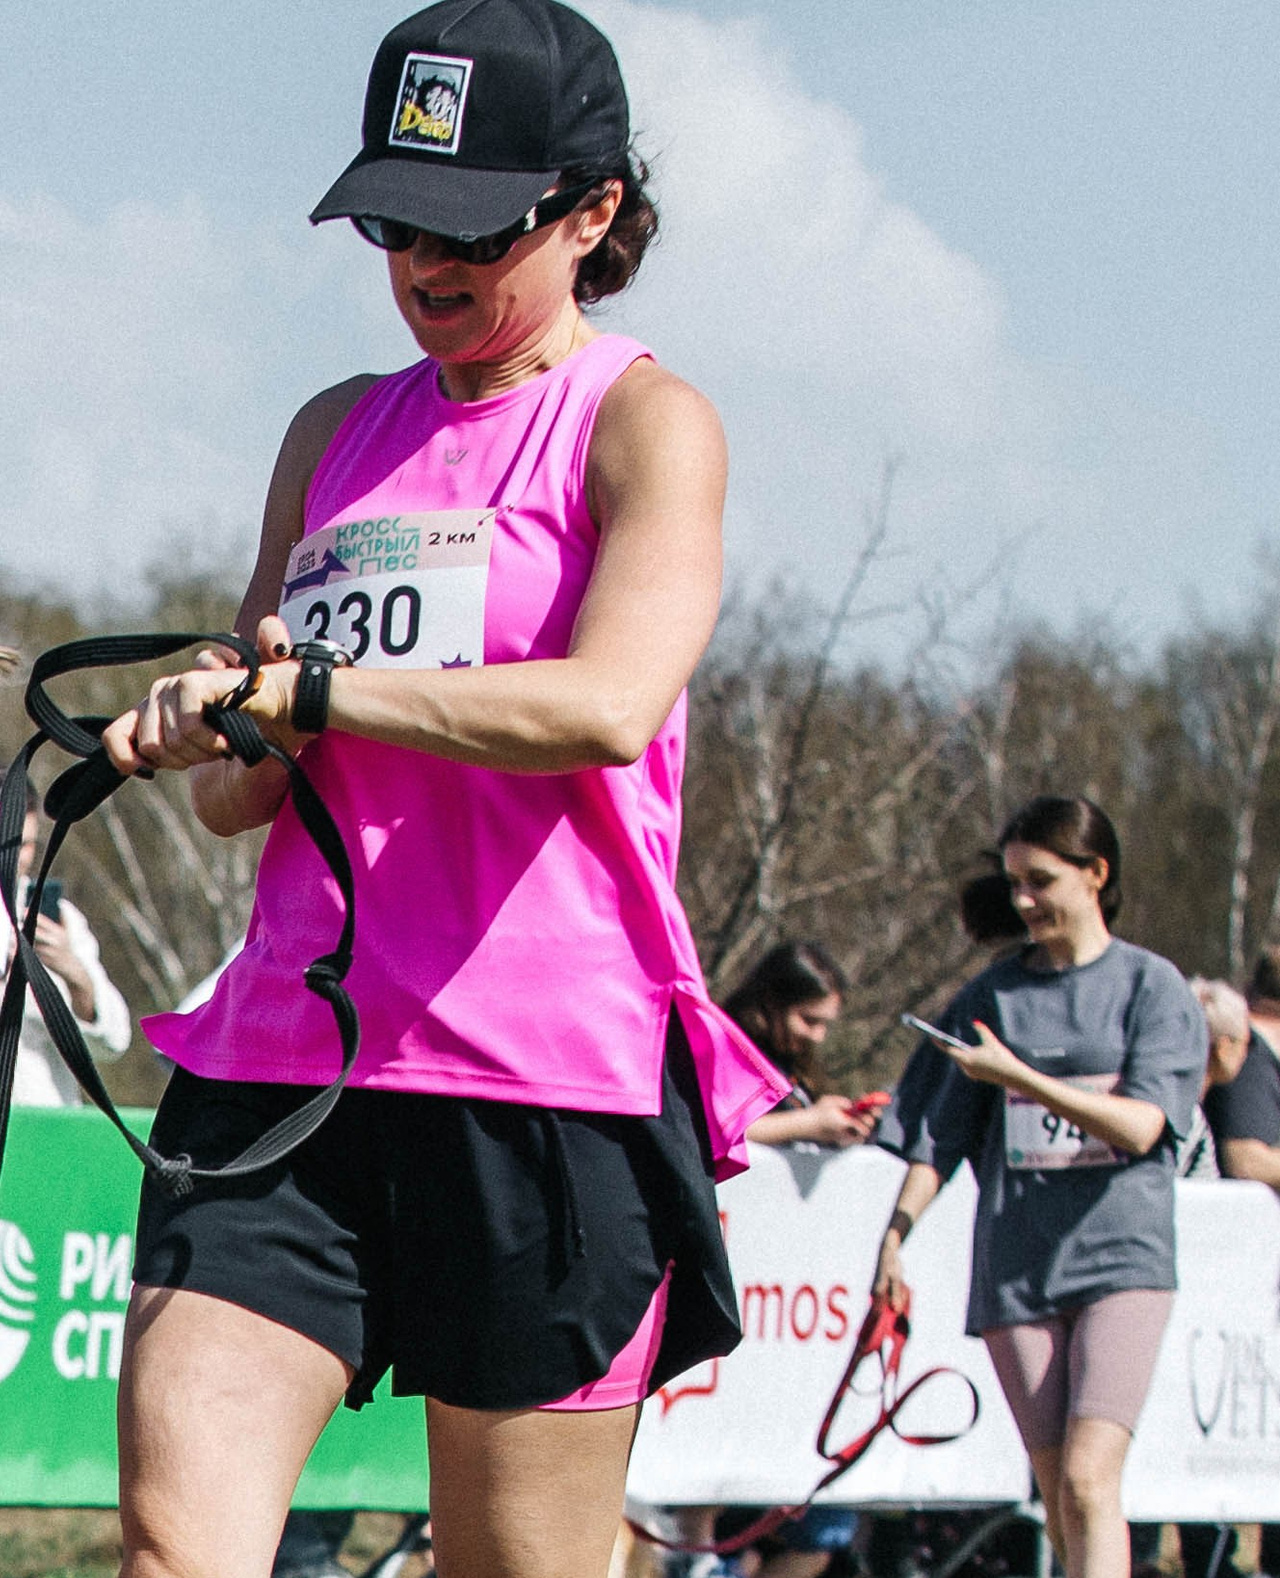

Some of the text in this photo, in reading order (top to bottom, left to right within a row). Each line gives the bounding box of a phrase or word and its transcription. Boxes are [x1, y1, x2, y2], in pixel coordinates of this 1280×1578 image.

[335, 516, 401, 543] КРОСС
[428, 532, 440, 545] 2
[741, 1284, 849, 1342] mos
